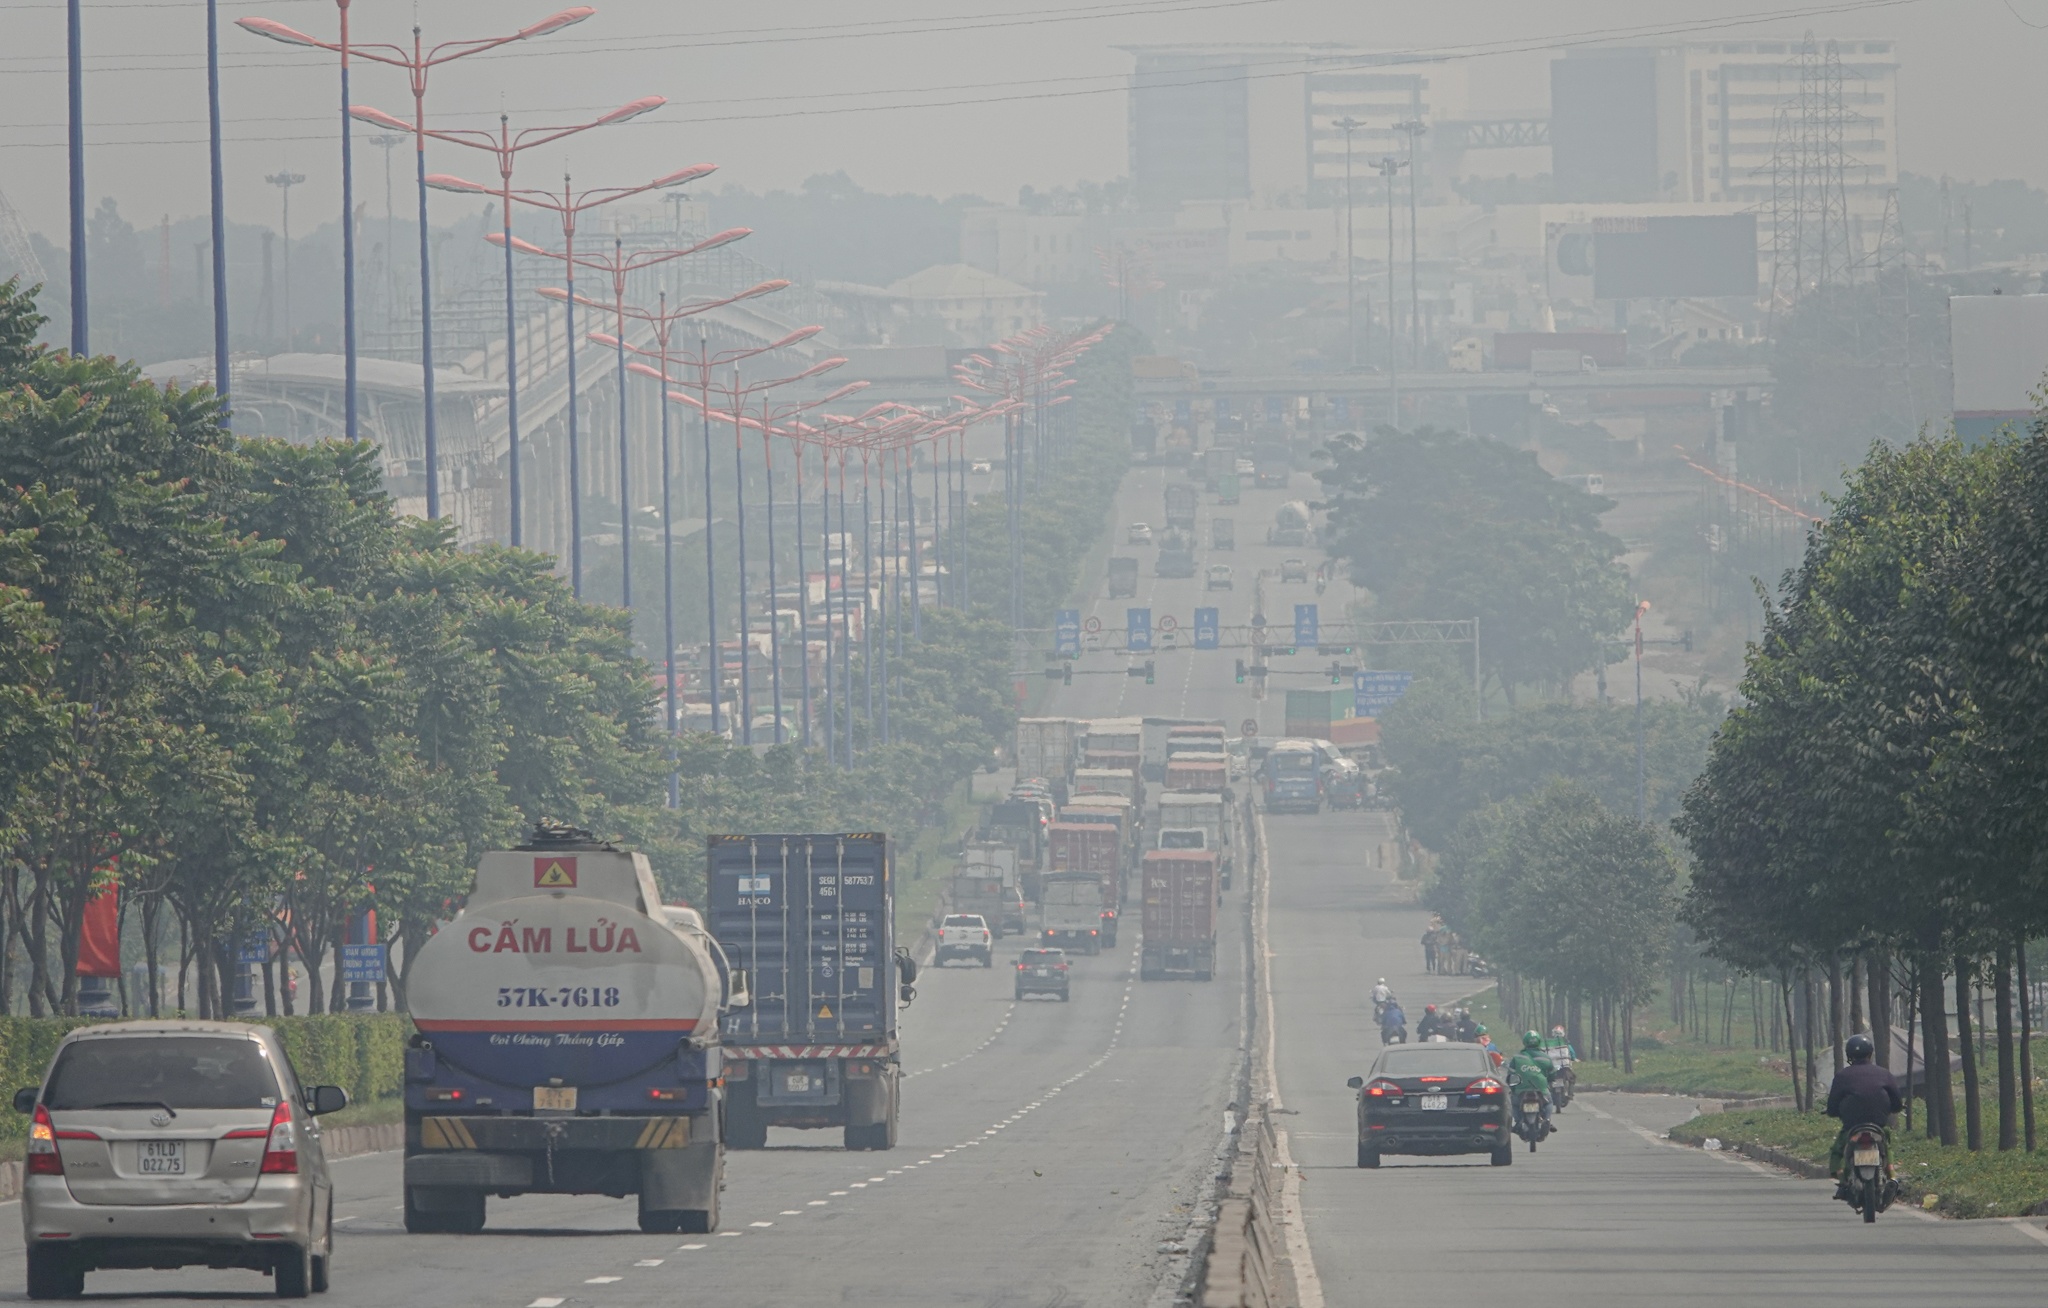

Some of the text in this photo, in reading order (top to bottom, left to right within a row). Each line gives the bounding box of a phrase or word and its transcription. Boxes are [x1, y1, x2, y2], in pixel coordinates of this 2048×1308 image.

[819, 886, 837, 896] 4561
[468, 918, 642, 953] CẤM LỬA
[497, 987, 620, 1008] 57K-7618
[489, 1034, 511, 1045] Coi
[147, 1142, 176, 1156] 61LD
